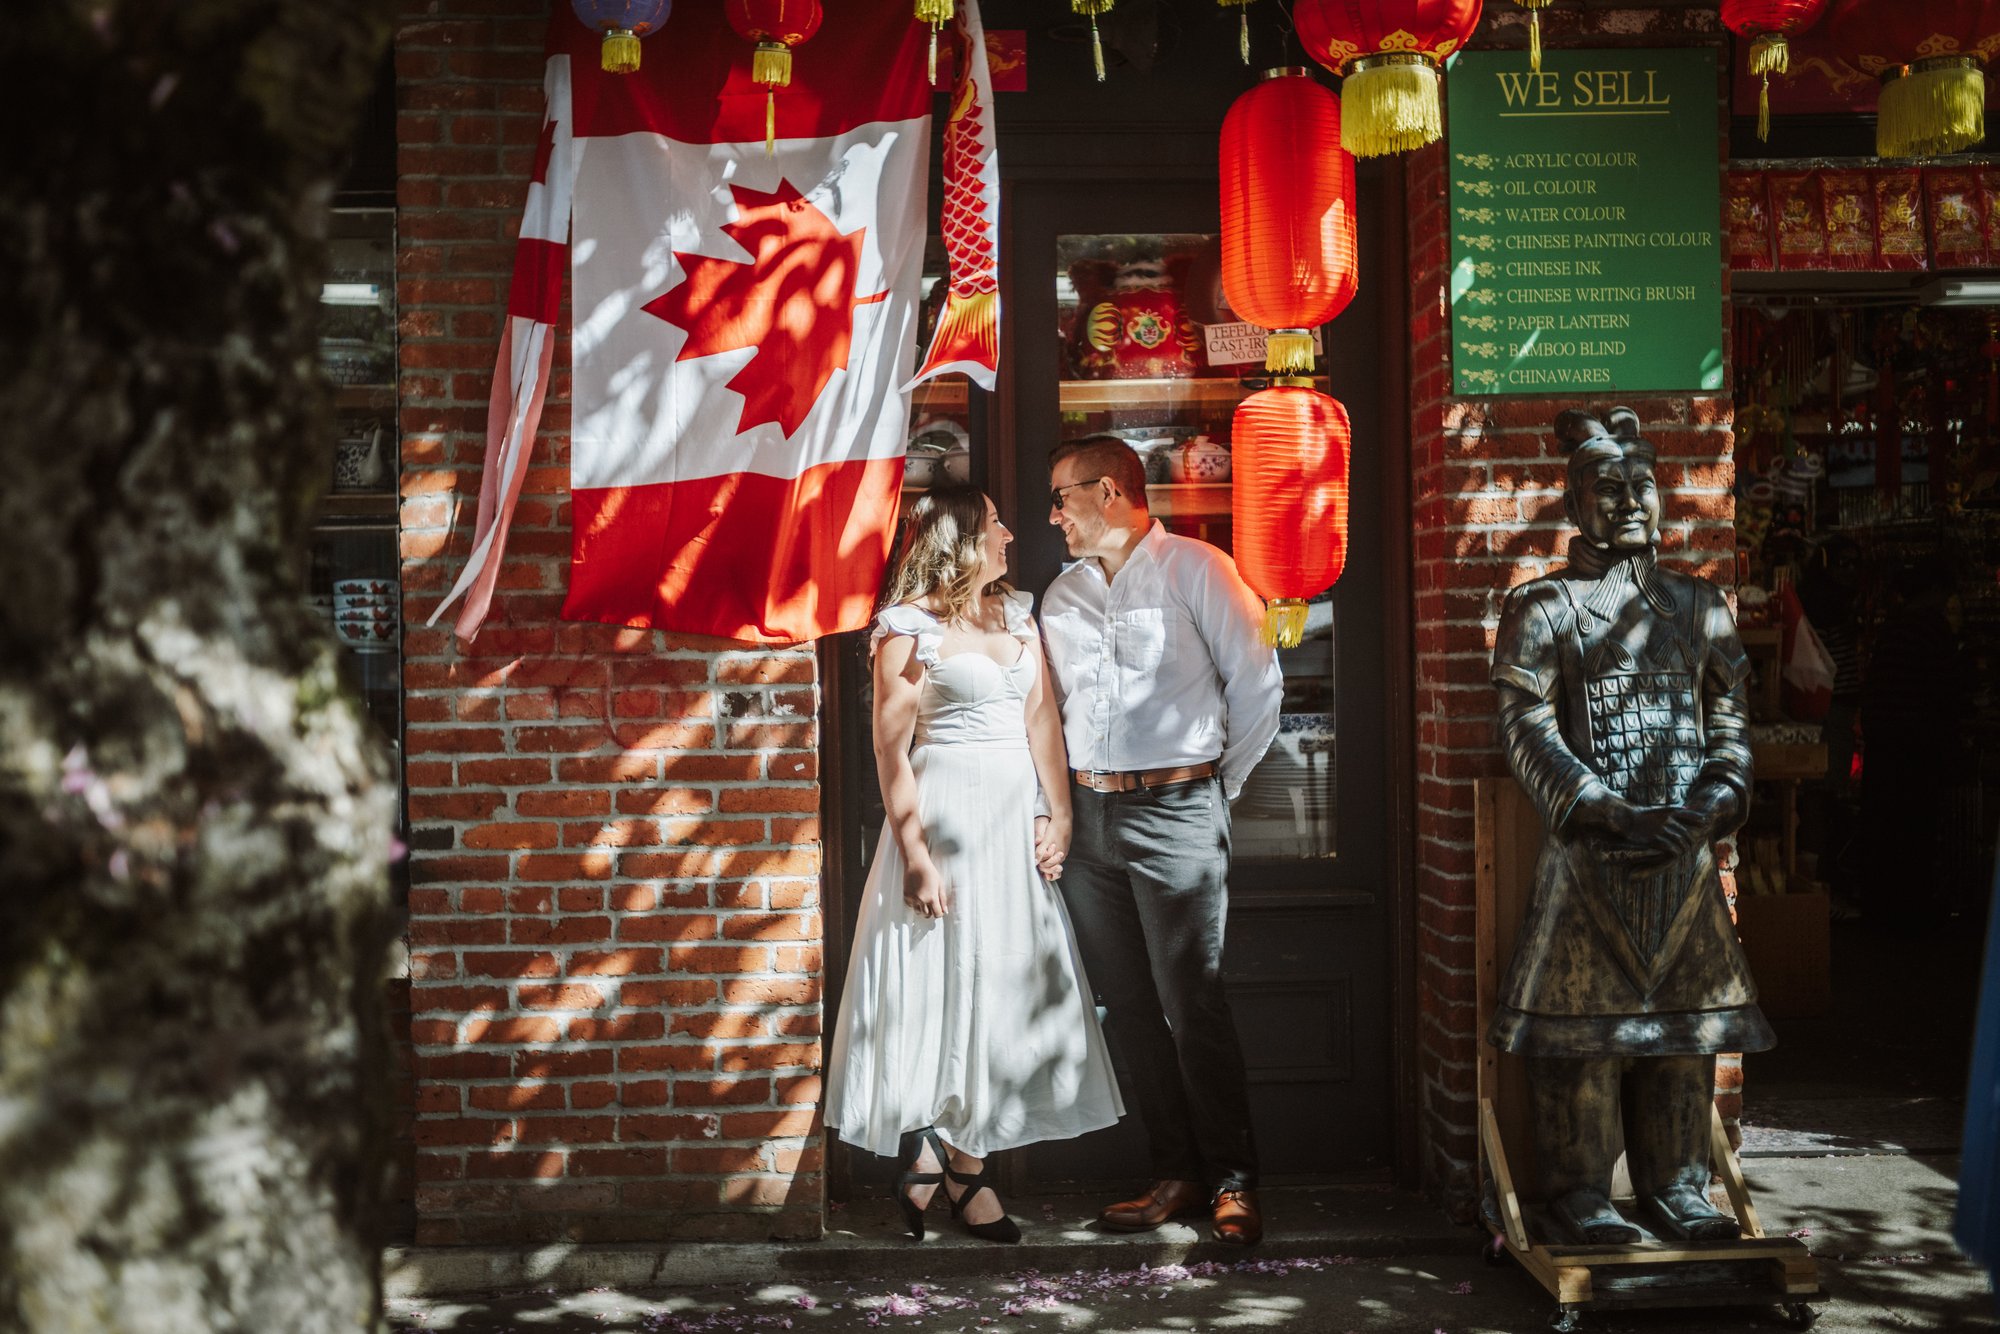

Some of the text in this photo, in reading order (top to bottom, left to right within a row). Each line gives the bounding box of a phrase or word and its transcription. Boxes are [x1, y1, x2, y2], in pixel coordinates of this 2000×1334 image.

[1496, 70, 1670, 107] WE SELL
[1504, 152, 1638, 168] ACRYLIC COLOUR
[1504, 180, 1597, 195] OIL COLOUR
[1505, 206, 1626, 221] WATER COLOUR
[1505, 232, 1711, 249] CHINESE PAINTING COLOUR
[1506, 261, 1602, 276] CHINESE INK
[1506, 286, 1696, 303] CHINESE WRITING BRUSH
[1507, 315, 1630, 330] PAPER LANTERN
[1231, 350, 1245, 360] NO
[1509, 341, 1625, 357] BAMBOO BLIND
[1508, 369, 1610, 383] CHINAWARES
